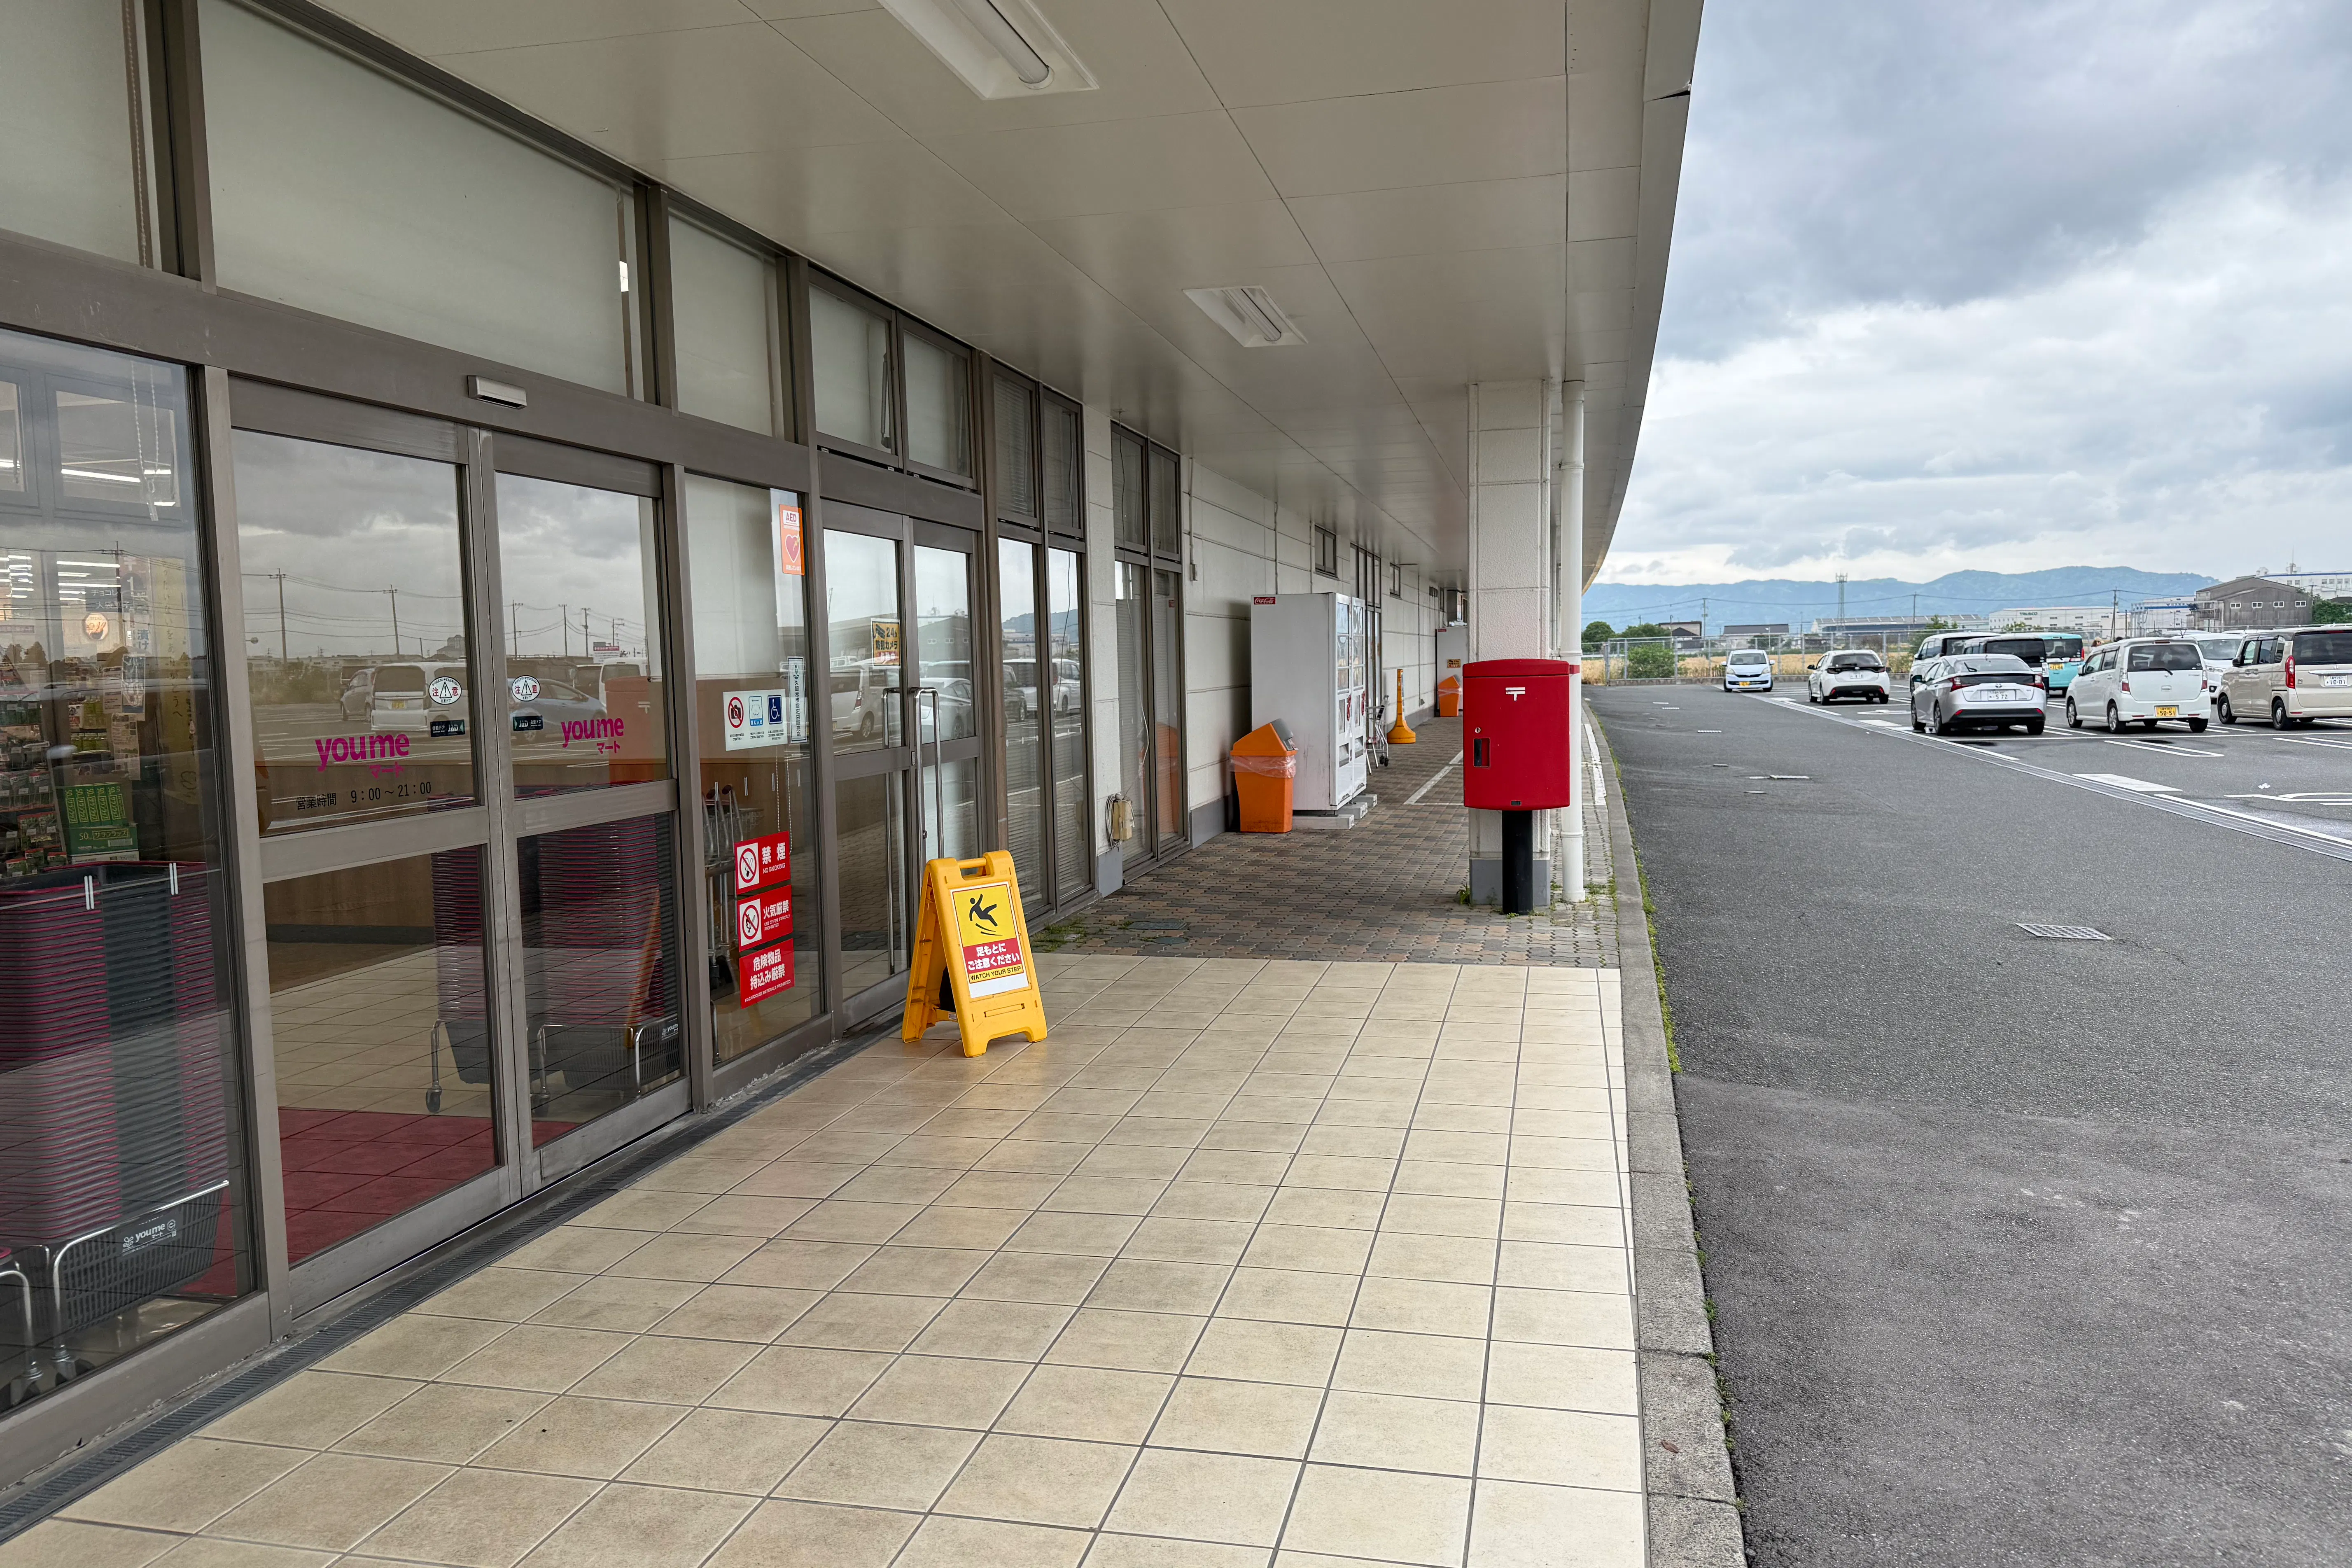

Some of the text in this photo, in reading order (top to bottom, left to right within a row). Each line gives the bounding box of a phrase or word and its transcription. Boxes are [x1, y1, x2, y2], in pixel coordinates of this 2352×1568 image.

[786, 512, 797, 522] AED
[560, 718, 624, 748] youme
[315, 734, 410, 772] youme
[597, 740, 621, 754] マート
[369, 761, 404, 779] マート
[296, 792, 337, 810] 営業時間
[769, 863, 785, 872] SMOKING
[763, 900, 789, 919] 火気厳禁
[976, 943, 1007, 957] 足もとに
[753, 948, 781, 971] 危険物品
[968, 952, 1020, 971] ご注意ください
[750, 963, 785, 991] 持込み厳禁
[970, 972, 990, 980] WATCH
[135, 1223, 166, 1243] youme
